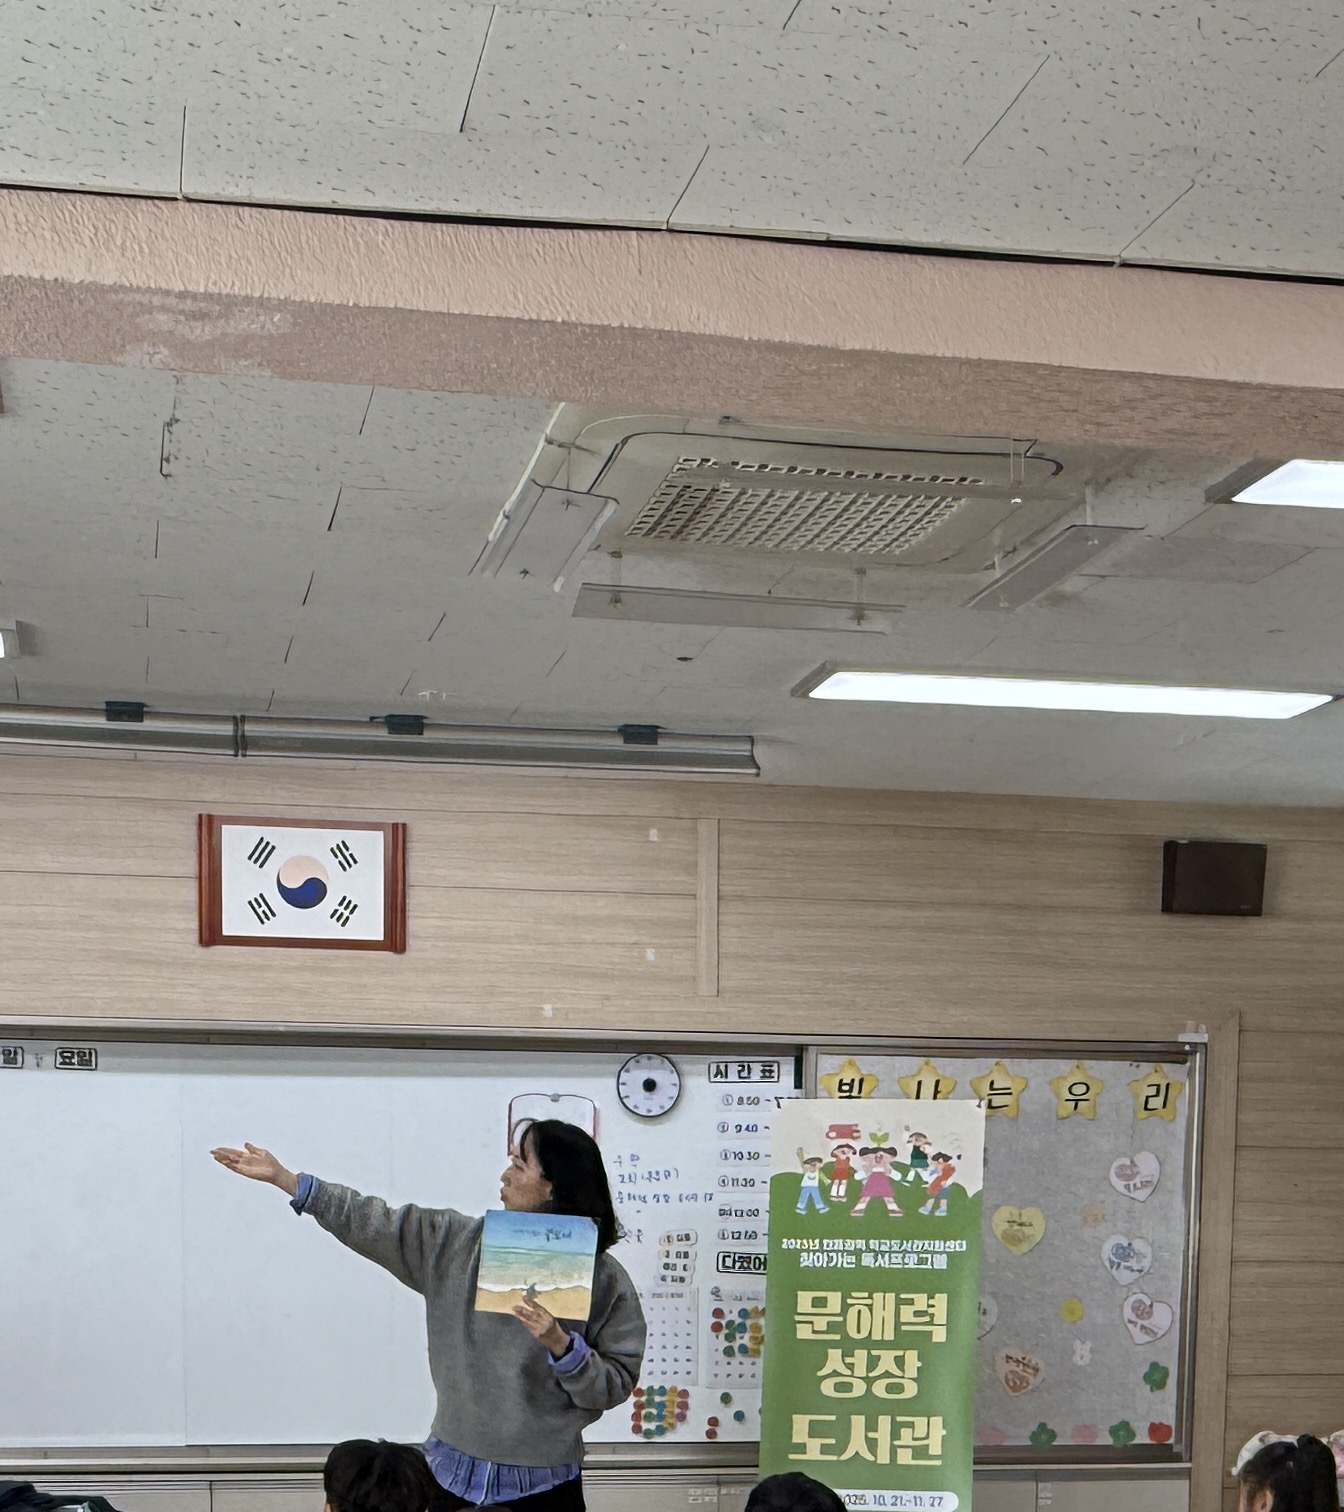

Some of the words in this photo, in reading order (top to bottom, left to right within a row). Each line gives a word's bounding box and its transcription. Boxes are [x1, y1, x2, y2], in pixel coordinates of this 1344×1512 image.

[794, 1290, 948, 1342] 문해력
[816, 1348, 922, 1399] 성장
[787, 1414, 947, 1466] 도서관
